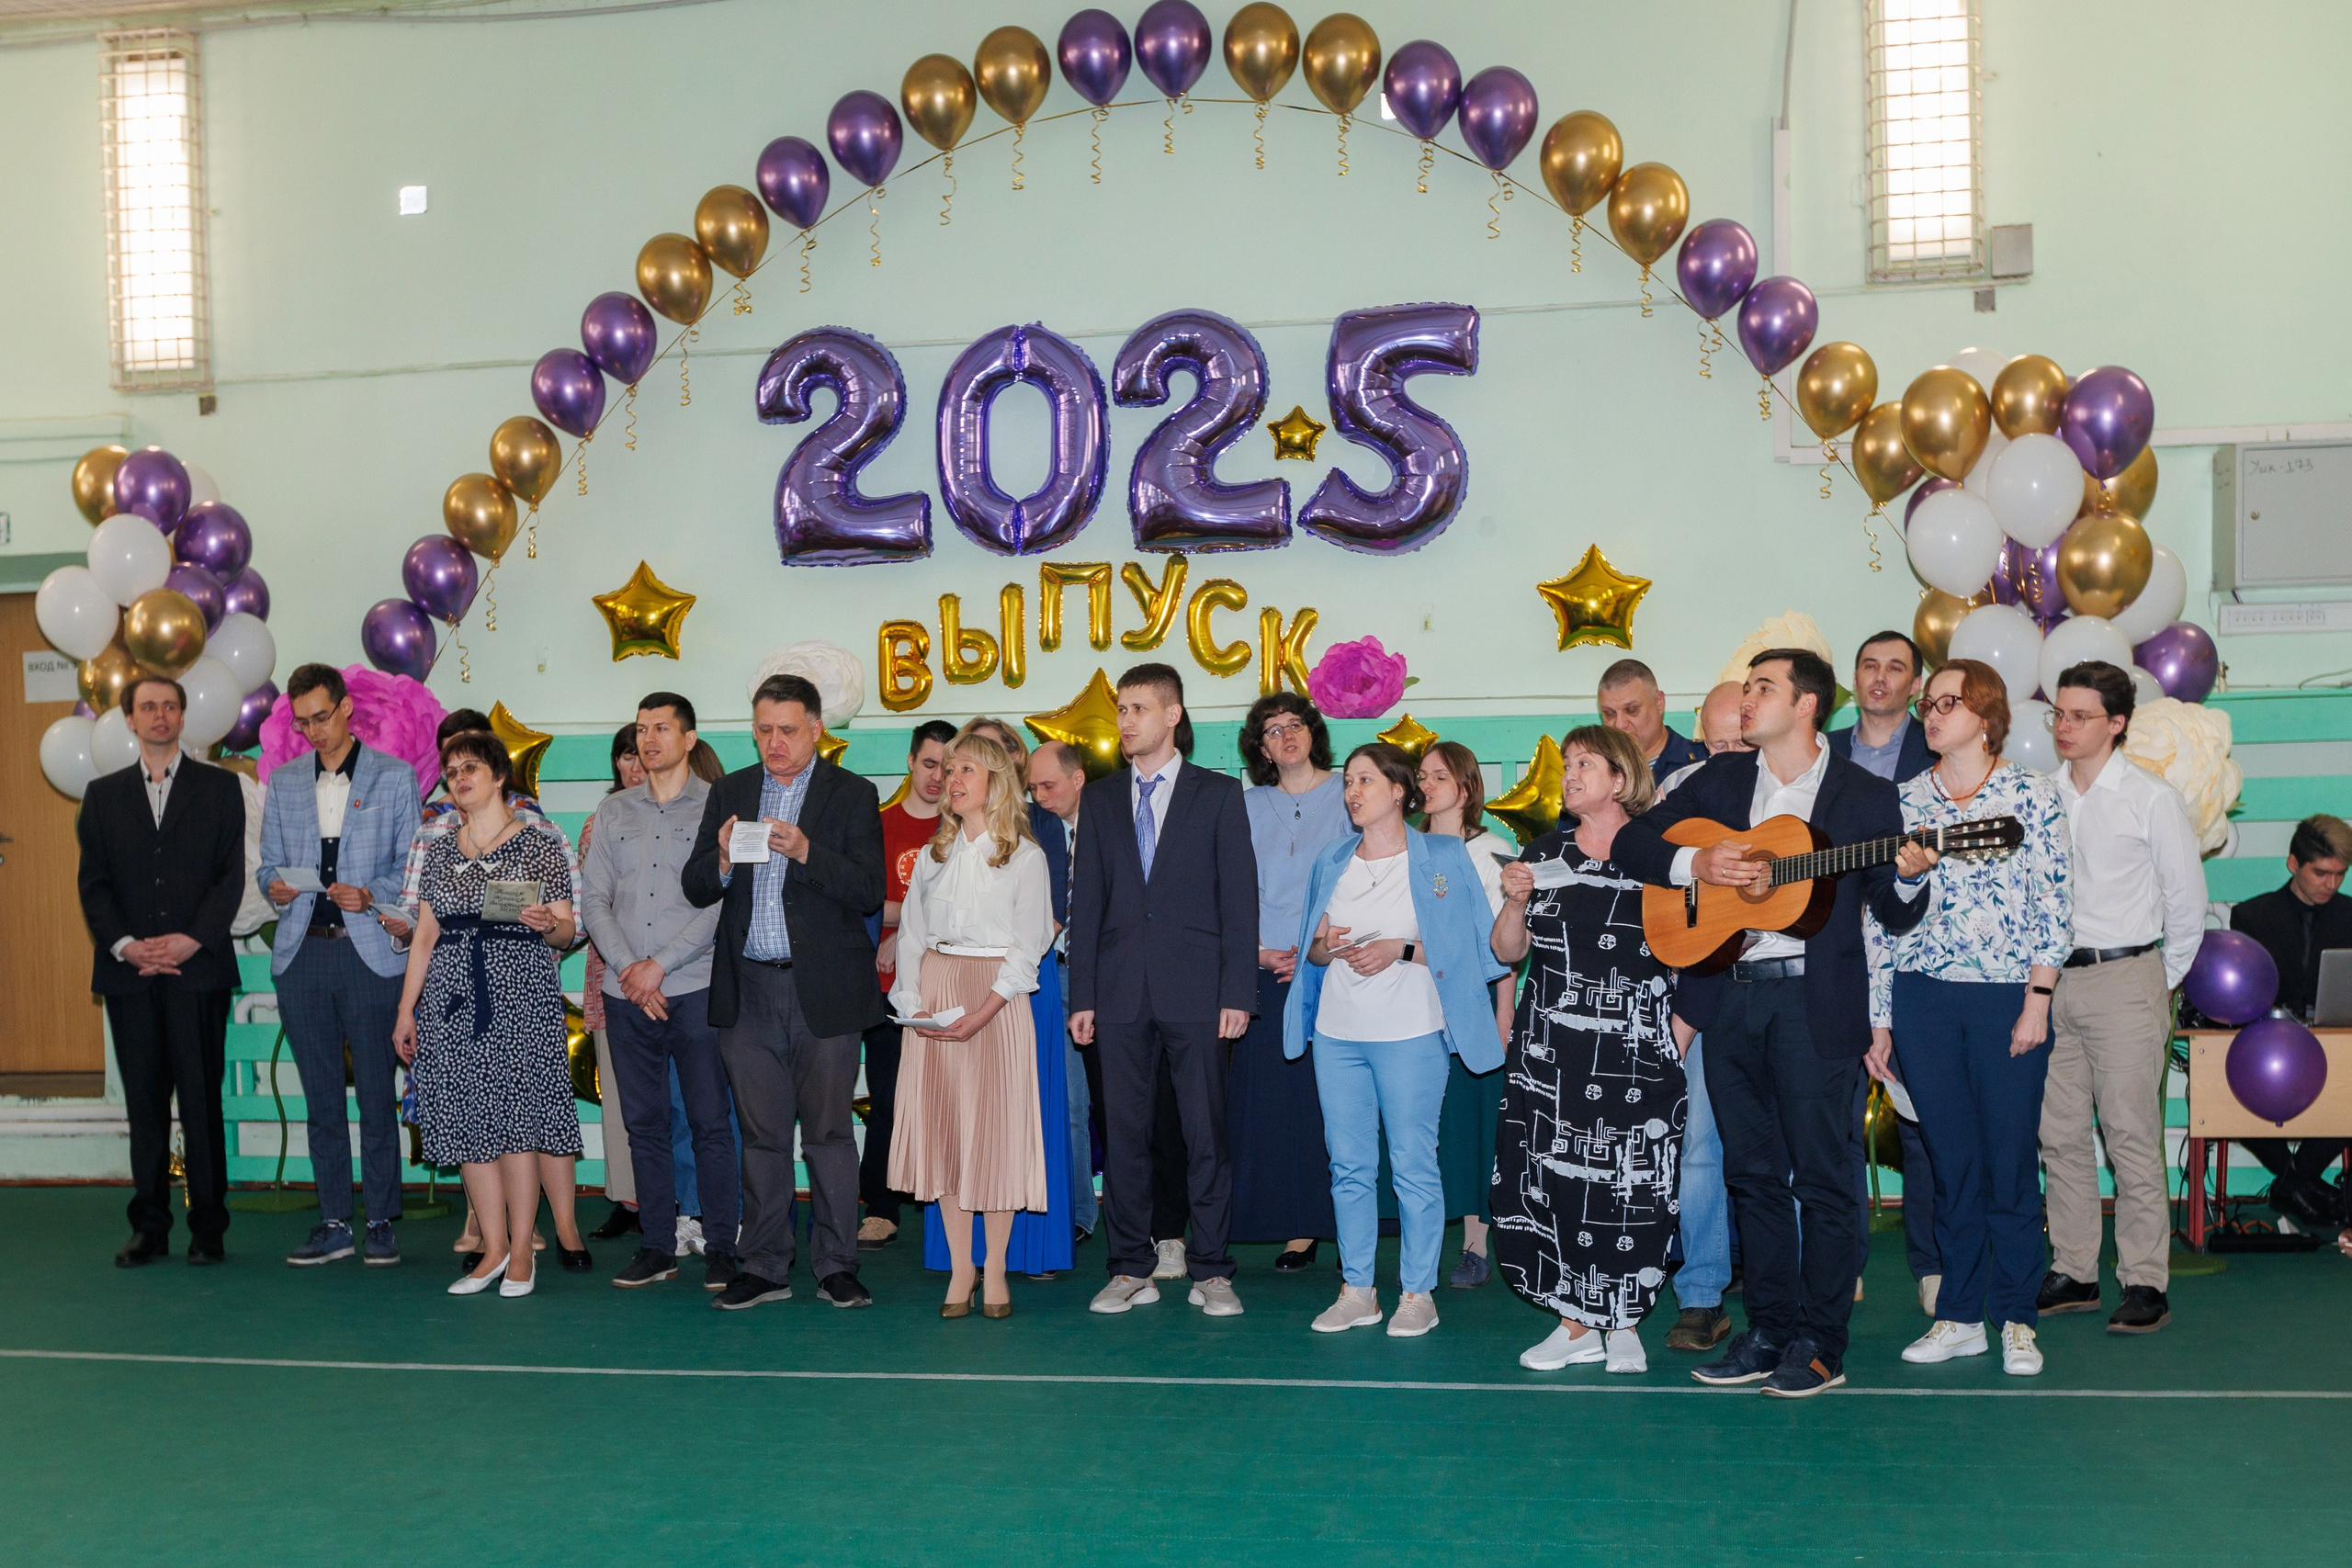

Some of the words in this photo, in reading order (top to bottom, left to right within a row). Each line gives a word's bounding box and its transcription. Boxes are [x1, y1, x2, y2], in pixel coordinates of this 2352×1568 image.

[756, 302, 1480, 567] 2025
[28, 660, 55, 673] ВХОД
[878, 554, 1319, 712] ВЫПУСК
